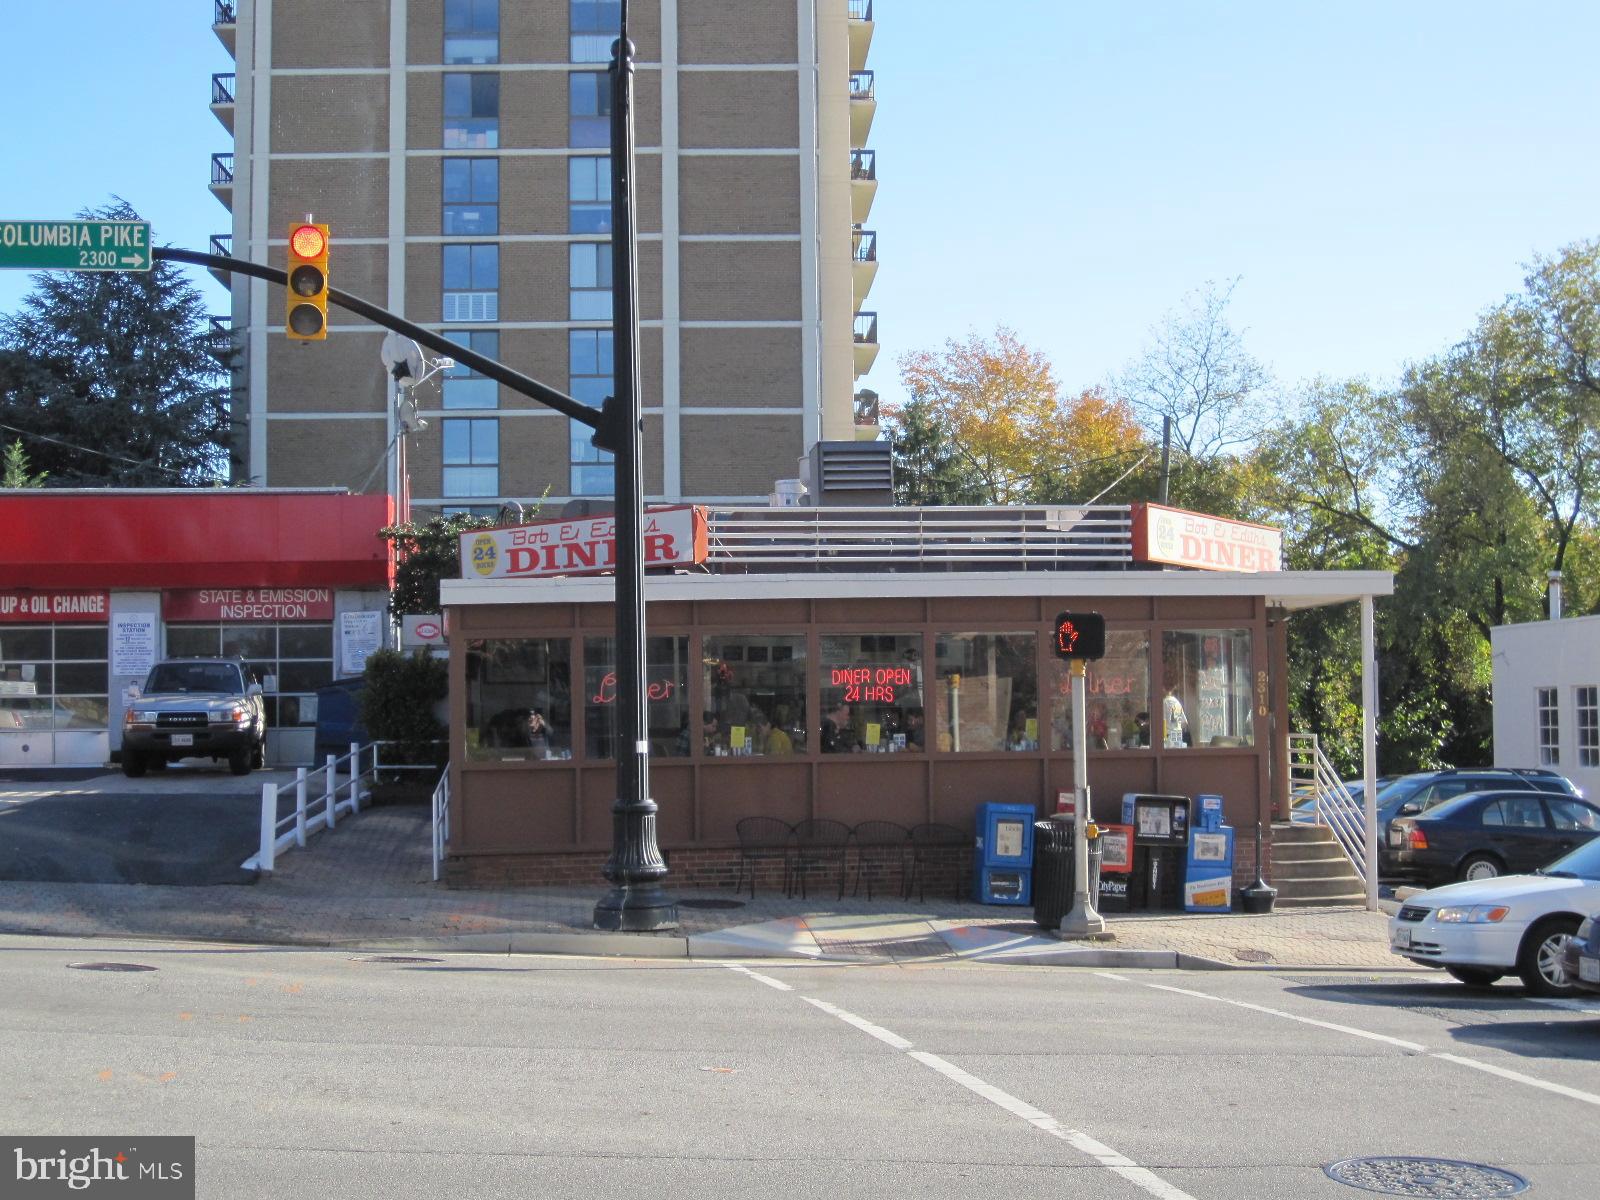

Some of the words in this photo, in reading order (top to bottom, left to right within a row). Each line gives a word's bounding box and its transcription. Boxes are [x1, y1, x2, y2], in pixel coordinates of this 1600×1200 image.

[0, 224, 91, 247] OLUMBIA
[100, 225, 145, 247] PIKE
[79, 251, 117, 266] 2300
[1181, 517, 1208, 536] Bob
[508, 528, 549, 546] Bob
[473, 546, 497, 561] 24
[1179, 533, 1275, 572] DINER
[20, 598, 28, 612] &
[31, 596, 51, 613] OIL
[53, 595, 105, 613] CHANGE
[199, 590, 242, 605] STATE
[245, 590, 256, 604] &
[259, 588, 329, 604] EMISSION
[220, 603, 307, 619] INSPECTION
[831, 668, 870, 685] DINER
[875, 668, 911, 685] OPEN
[845, 685, 860, 702] 24
[864, 686, 894, 703] HRS
[1257, 670, 1268, 717] 2310
